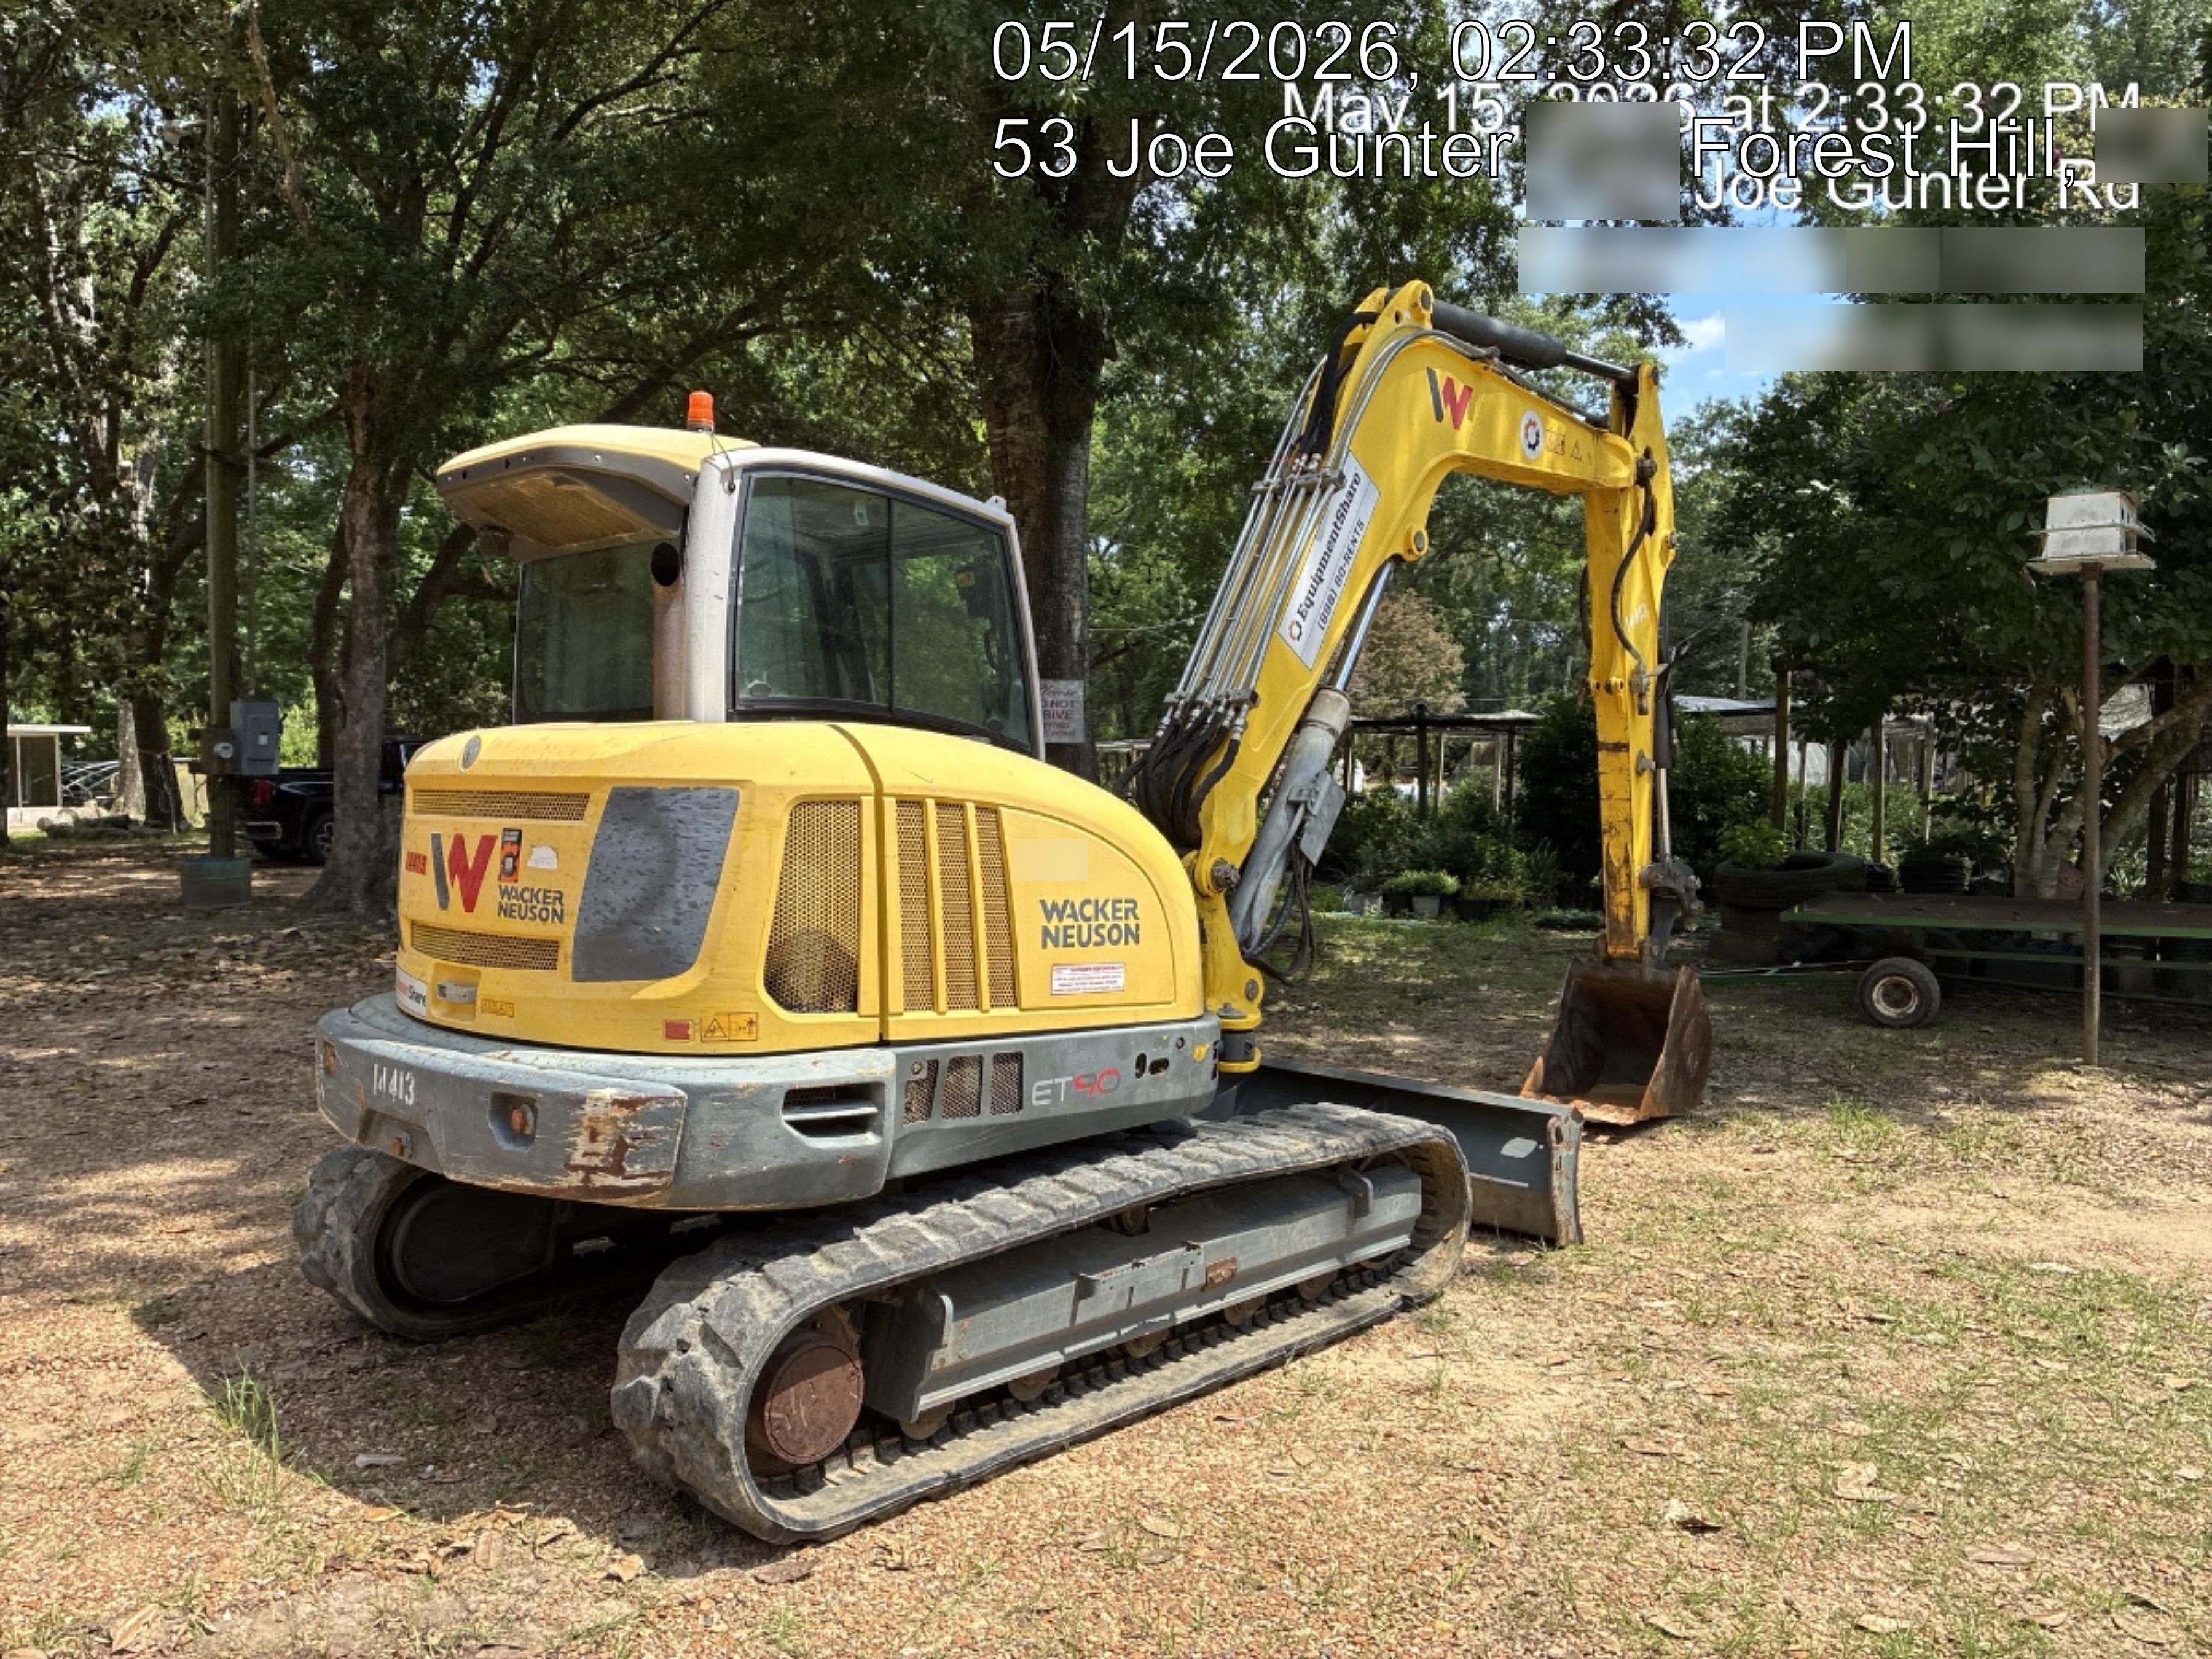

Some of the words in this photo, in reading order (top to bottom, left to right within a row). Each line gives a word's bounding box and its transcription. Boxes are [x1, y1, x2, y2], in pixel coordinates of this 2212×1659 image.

[1297, 472, 1361, 622] EquipmentShare
[1043, 710, 1074, 720] RIVE
[498, 885, 565, 906] WACKER
[497, 902, 565, 924] NEUSON
[1039, 898, 1140, 923] WACKER
[1041, 923, 1140, 949] NEUSON
